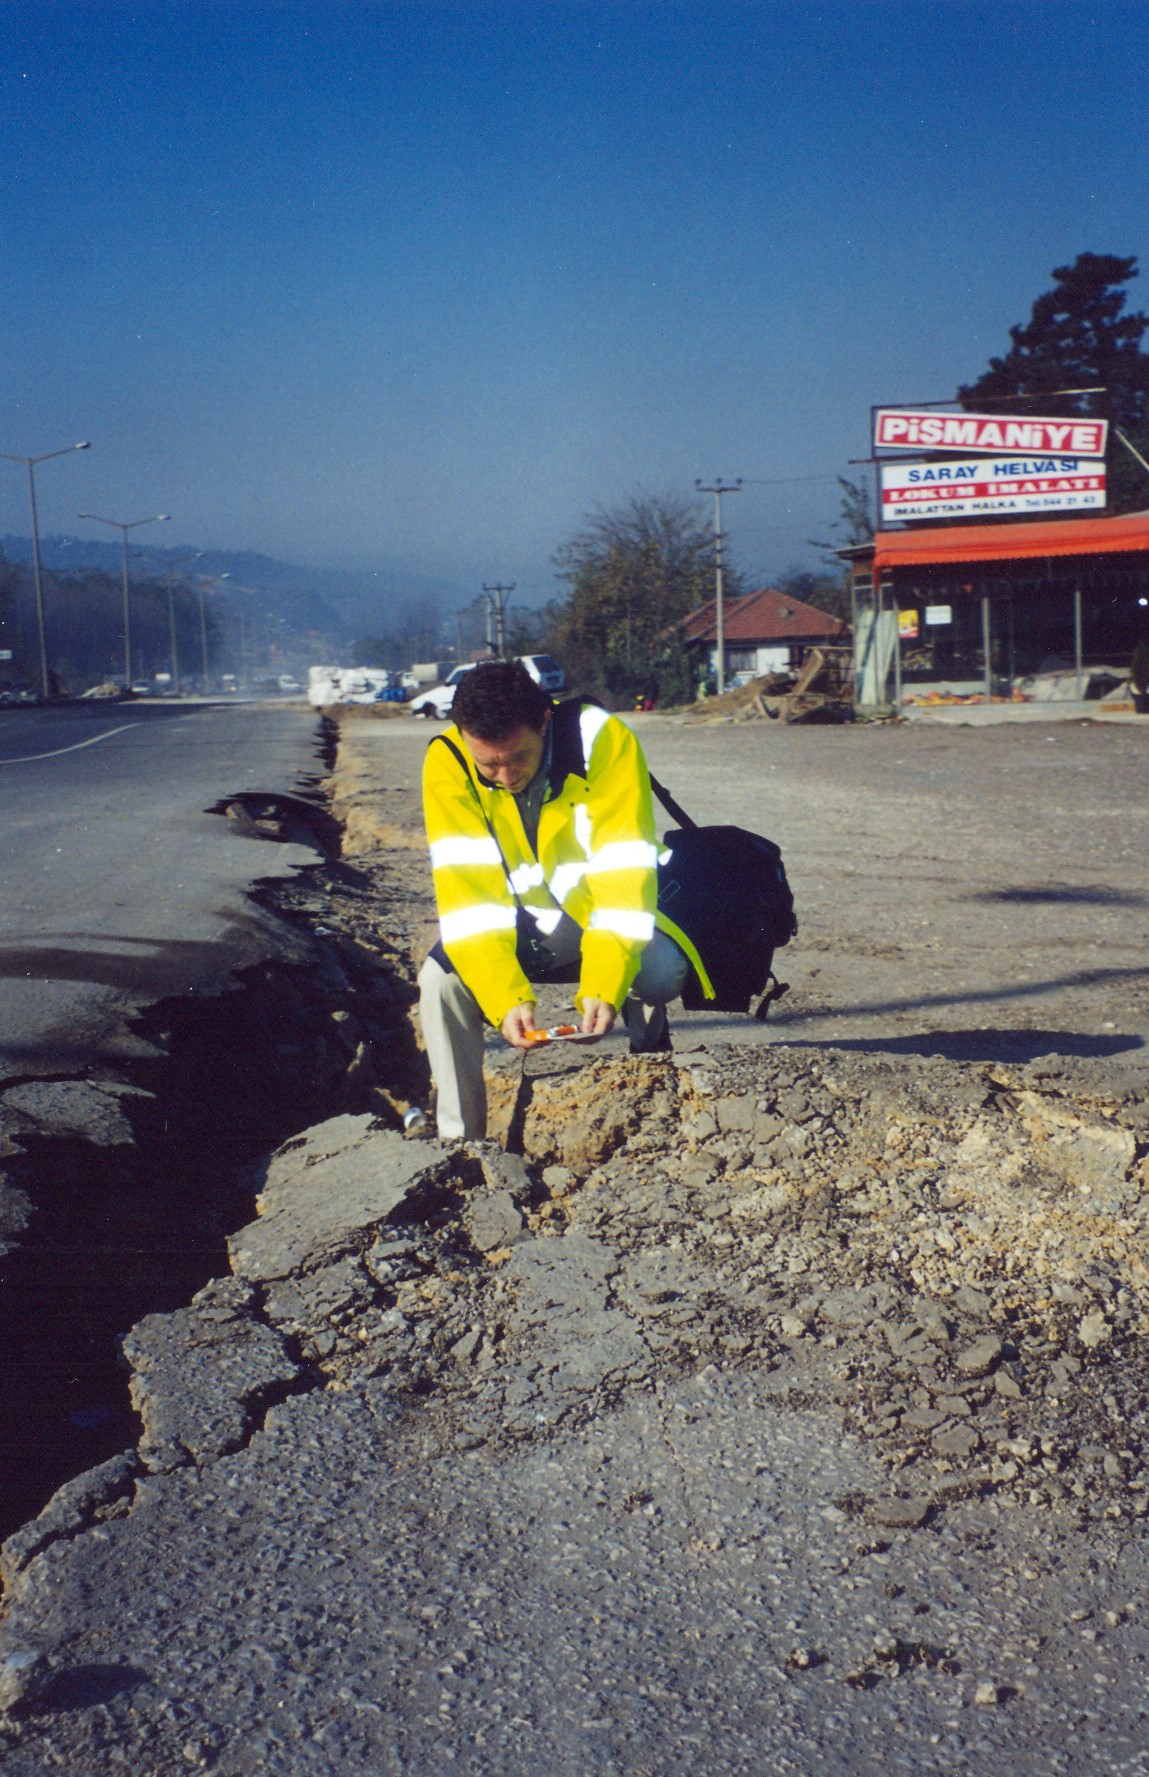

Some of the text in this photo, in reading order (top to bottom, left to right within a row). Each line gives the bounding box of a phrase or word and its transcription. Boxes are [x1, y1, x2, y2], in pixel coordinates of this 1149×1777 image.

[908, 460, 1078, 483] SARAY HELVASI
[889, 486, 976, 502] LOKUM
[972, 499, 1016, 509] HALKA
